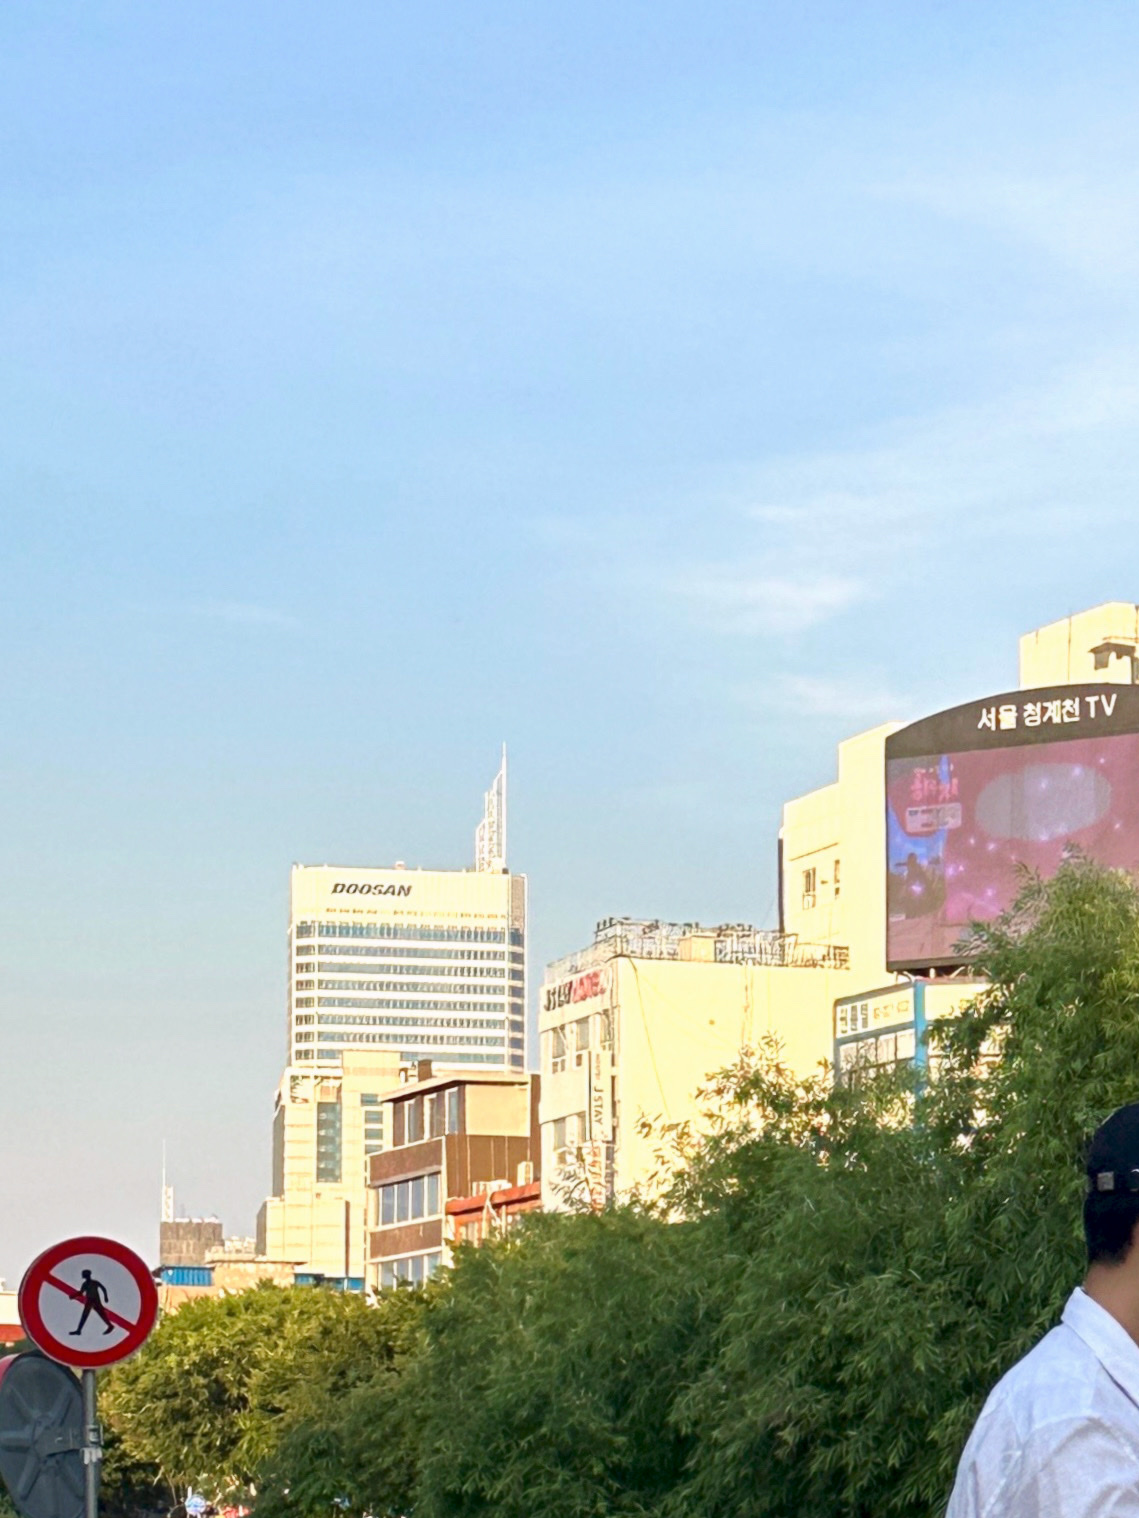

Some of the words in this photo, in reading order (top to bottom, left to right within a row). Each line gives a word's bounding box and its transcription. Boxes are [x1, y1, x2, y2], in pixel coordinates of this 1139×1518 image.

[977, 704, 1018, 731] 서울
[1023, 697, 1080, 727] 청계천
[1085, 693, 1117, 719] TV
[331, 882, 412, 897] DOOSAN
